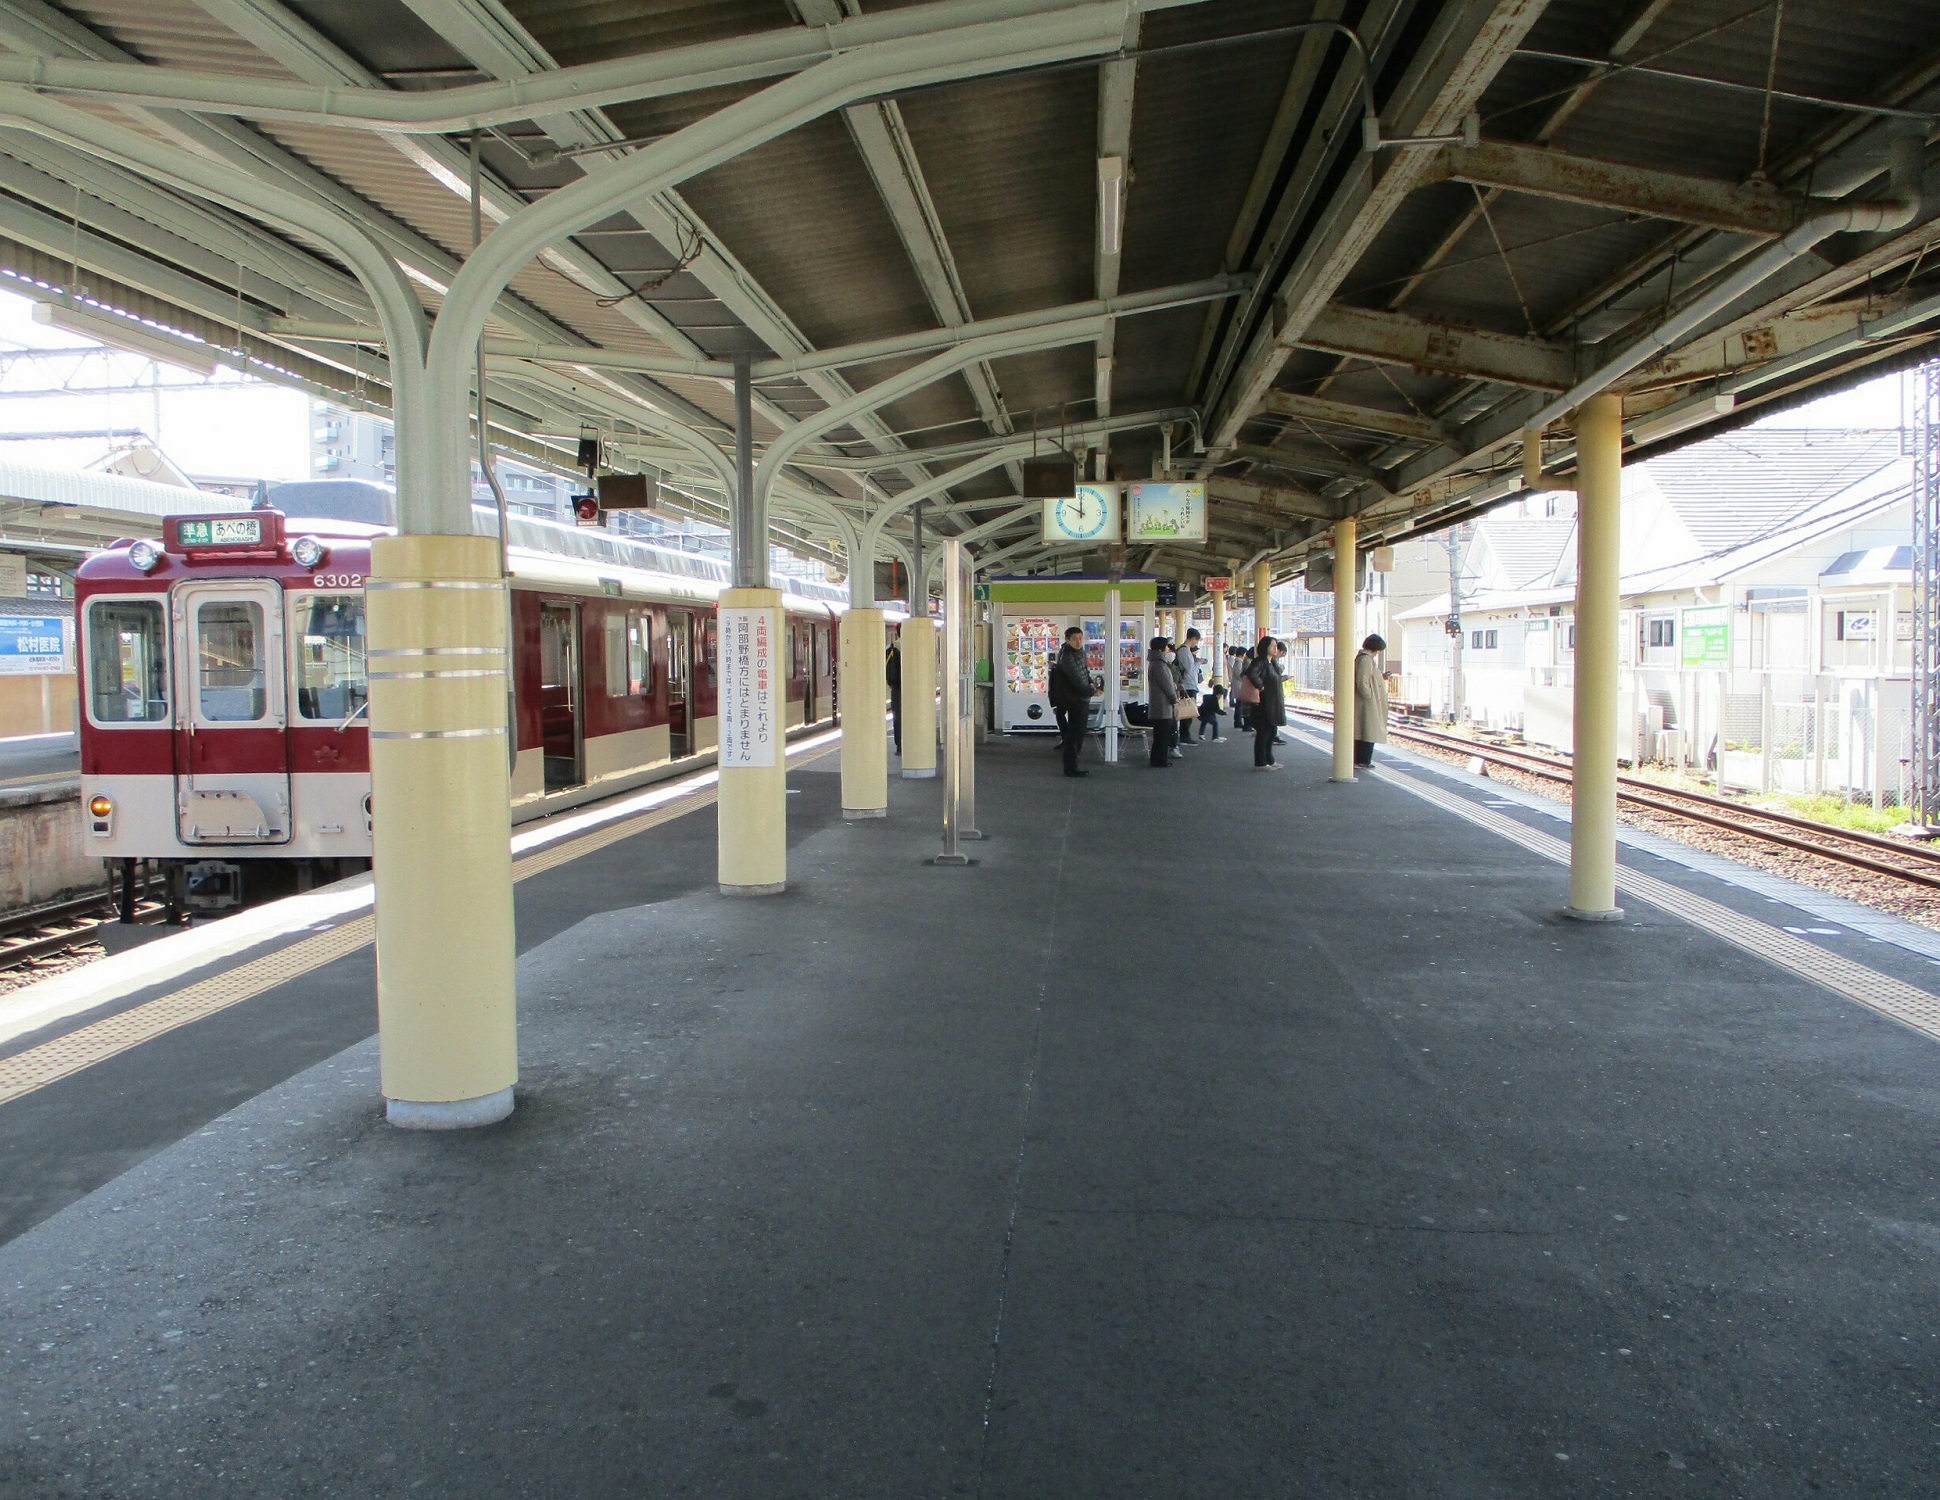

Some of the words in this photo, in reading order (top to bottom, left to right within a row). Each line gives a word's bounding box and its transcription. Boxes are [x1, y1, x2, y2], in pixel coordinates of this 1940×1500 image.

[1096, 509, 1102, 517] 3
[183, 522, 208, 538] 準急
[216, 520, 257, 537] あべの橋
[1078, 525, 1084, 533] 6
[314, 573, 362, 587] 6302
[17, 636, 61, 653] 松村医院
[756, 615, 769, 743] 4両編成の電車はこれより
[738, 622, 751, 761] 阿部野橋方にはとまりません
